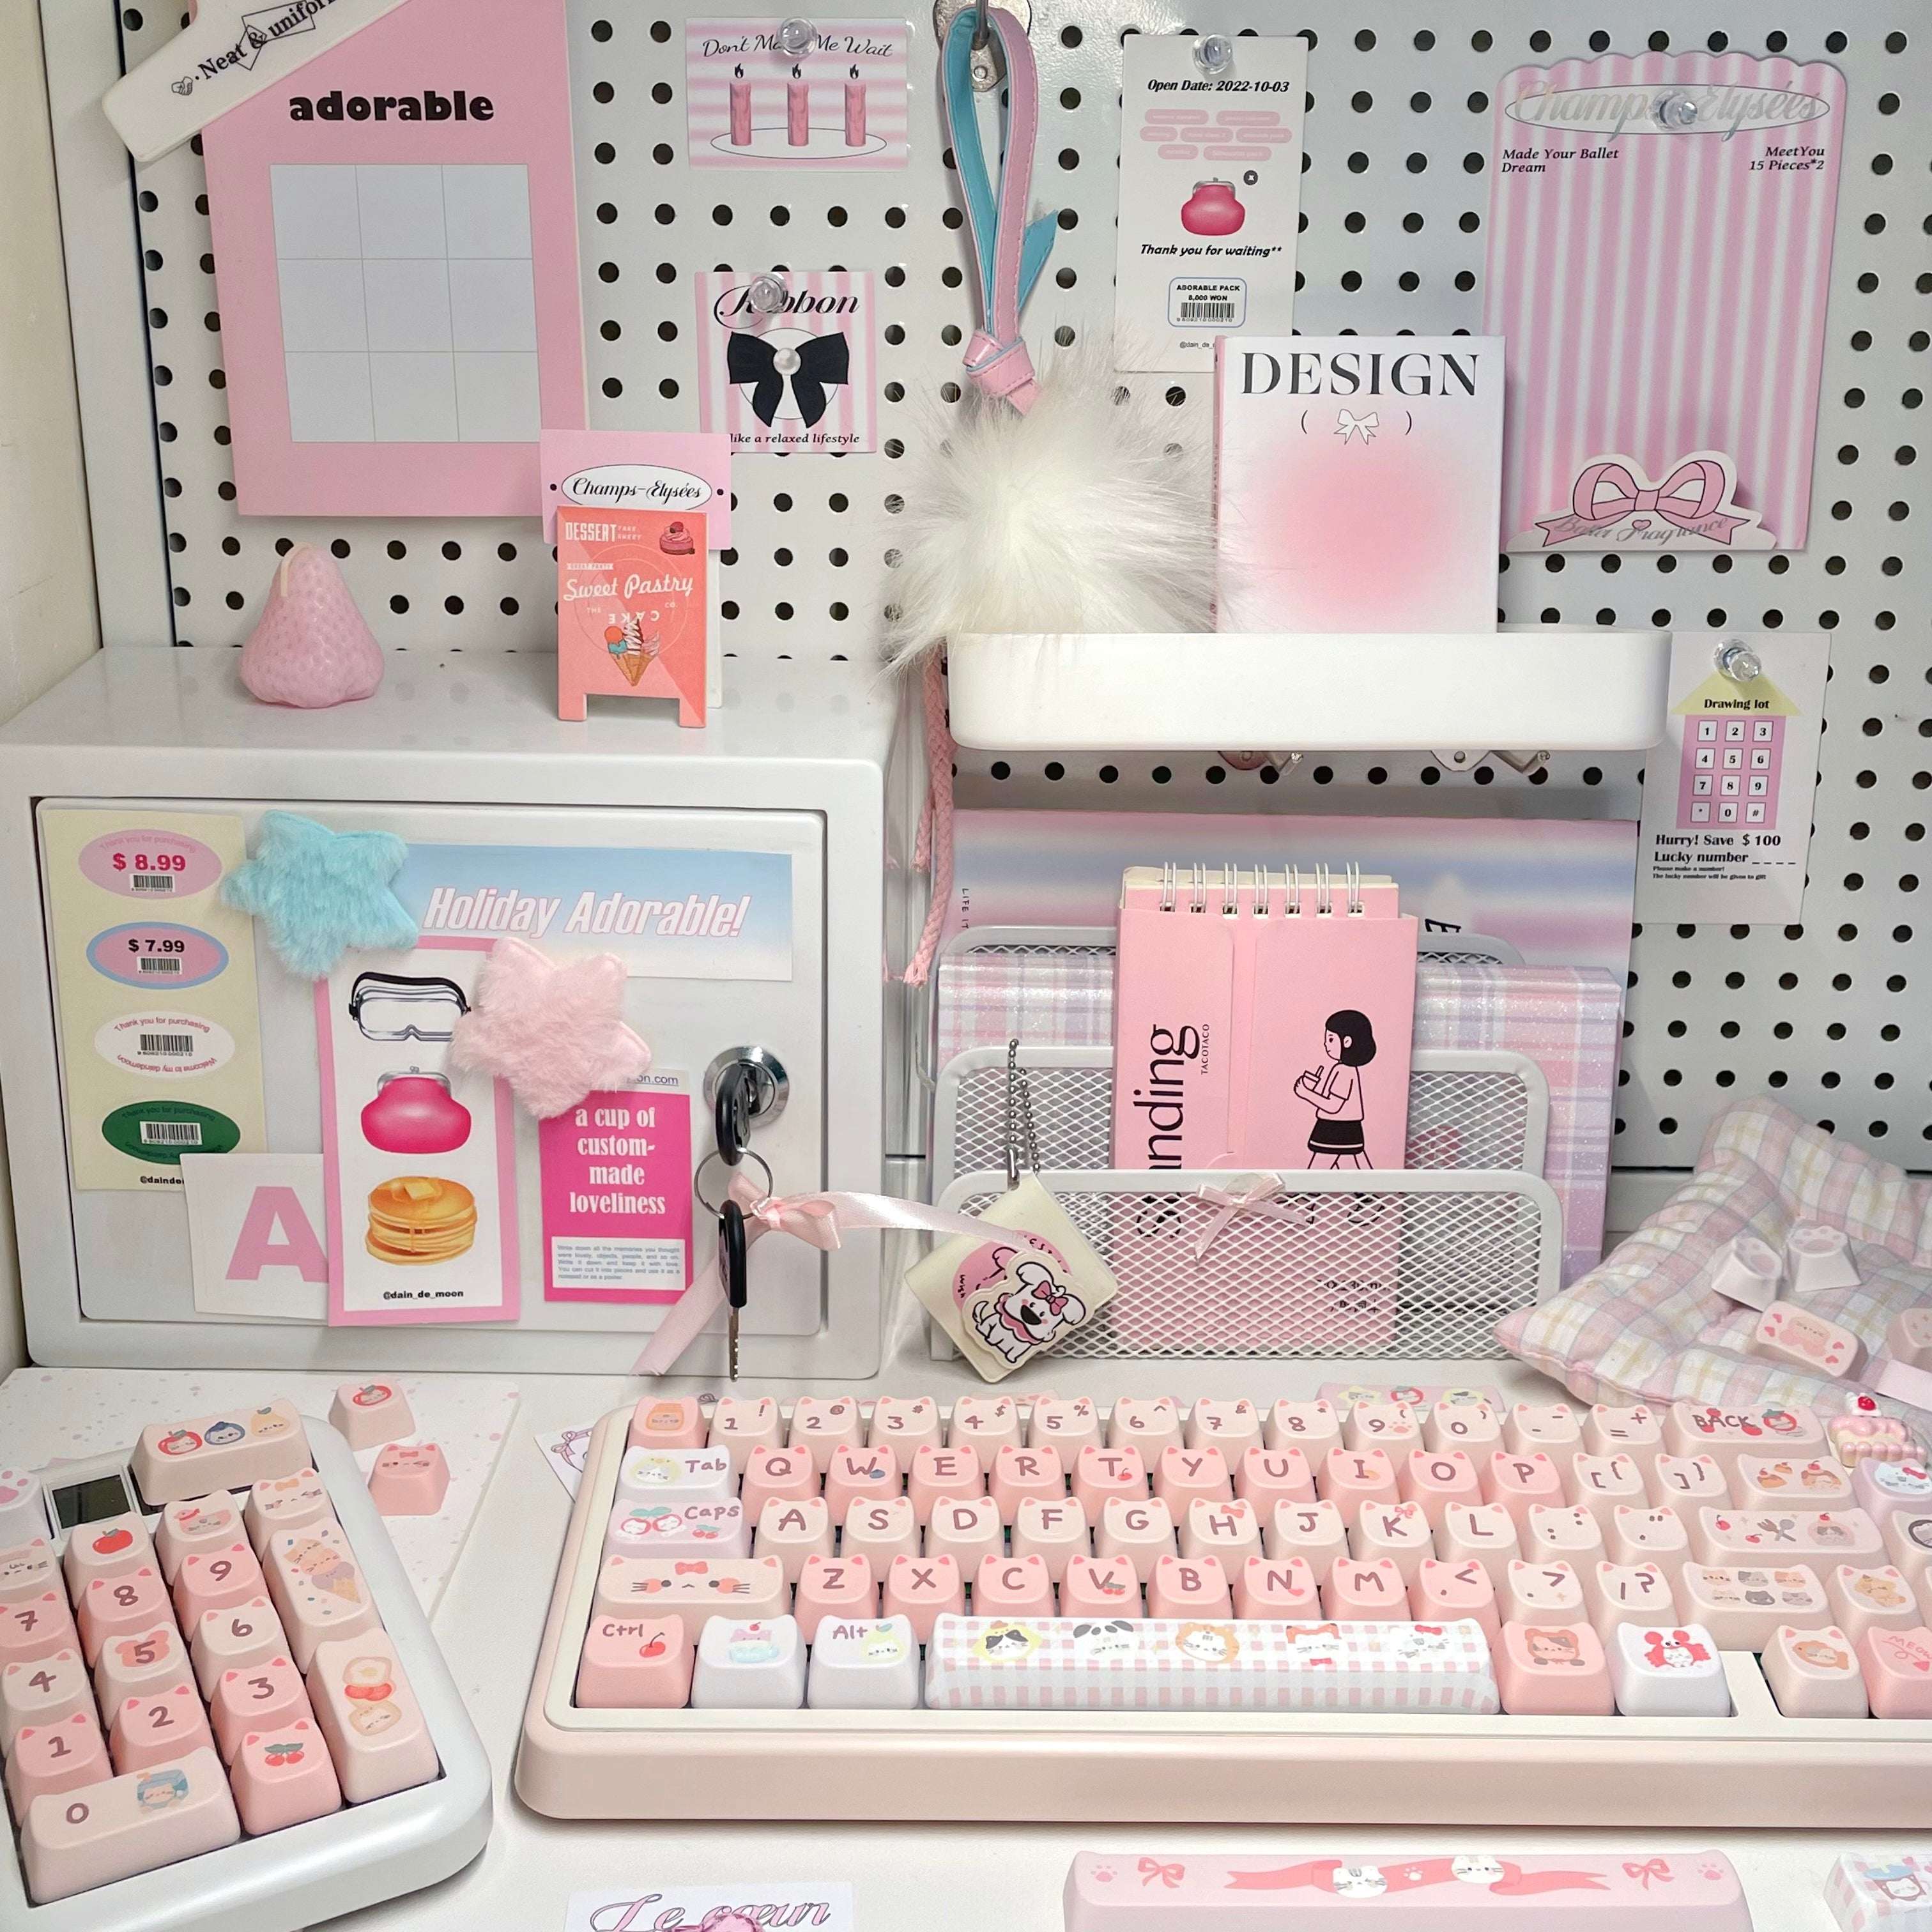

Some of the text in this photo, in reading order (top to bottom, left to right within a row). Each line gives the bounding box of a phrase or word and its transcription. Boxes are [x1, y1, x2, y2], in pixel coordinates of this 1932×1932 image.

[197, 0, 336, 79] Neat & unifor
[703, 35, 750, 57] Don't
[845, 36, 893, 57] Wait
[1148, 79, 1290, 92] Open Date: 2022-10-03
[289, 91, 494, 121] adorable
[1503, 148, 1619, 160] Made Your Ballet
[1502, 162, 1545, 173] Dream
[1749, 160, 1763, 170] 15
[1140, 244, 1177, 255] Thank
[1180, 246, 1202, 257] you
[1206, 245, 1223, 256] for
[1241, 351, 1479, 396] DESIGN
[730, 433, 751, 443] like
[765, 433, 809, 443] relaxed
[813, 433, 859, 445] lifestyle
[565, 522, 617, 542] DESSERT
[562, 574, 693, 601] Sweet Pastry
[1704, 699, 1769, 710] Drawing lot
[1705, 727, 1767, 736] 1 2 3
[1701, 755, 1764, 764] 4 5 6
[1699, 781, 1706, 790] 7
[1754, 782, 1761, 790] 9
[1724, 809, 1731, 817] 0
[1655, 833, 1781, 847] Hurry! Save $ 100
[113, 852, 186, 871] $ 8.99
[1654, 851, 1749, 864] Lucky number
[962, 888, 970, 912] LIFE
[423, 886, 752, 939] Holiday Adorable!
[128, 939, 185, 953] $ 7.99
[114, 1019, 139, 1031] Thank
[139, 1018, 154, 1026] you
[168, 1017, 211, 1033] purchasing
[1201, 1023, 1210, 1075] TACOTACO
[163, 1064, 174, 1072] my
[575, 1107, 656, 1130] a cup of
[578, 1135, 656, 1156] custom-
[140, 1176, 185, 1185] @dainde
[589, 1164, 645, 1185] made
[569, 1192, 666, 1215] loveliness
[225, 1186, 328, 1284] A
[383, 1289, 464, 1301] @dain_de_moon
[724, 1418, 739, 1430] 1
[806, 1416, 822, 1429] 2
[887, 1416, 904, 1430] 3
[964, 1415, 984, 1430] 4
[1046, 1416, 1064, 1430] 5
[1129, 1415, 1145, 1429] 6
[1206, 1416, 1222, 1430] 7
[1287, 1416, 1307, 1432] 8
[1368, 1418, 1386, 1432] 9
[1692, 1414, 1756, 1433] BACK
[684, 1457, 728, 1473] Tab
[765, 1456, 1535, 1483] Q W E R T Y U I O P
[684, 1505, 739, 1519] Caps
[778, 1508, 1494, 1537] A S D F G H J K L
[210, 1560, 232, 1582] 9
[822, 1567, 1384, 1592] Z X C V B N M
[113, 1585, 139, 1606] 8
[14, 1610, 38, 1632] 7
[231, 1618, 253, 1637] 6
[602, 1624, 643, 1637] Ctrl
[832, 1625, 868, 1639] Alt
[134, 1639, 157, 1664] 5
[28, 1671, 57, 1692] 4
[247, 1677, 275, 1699] 3
[148, 1706, 174, 1728] 2
[48, 1736, 72, 1758] 1
